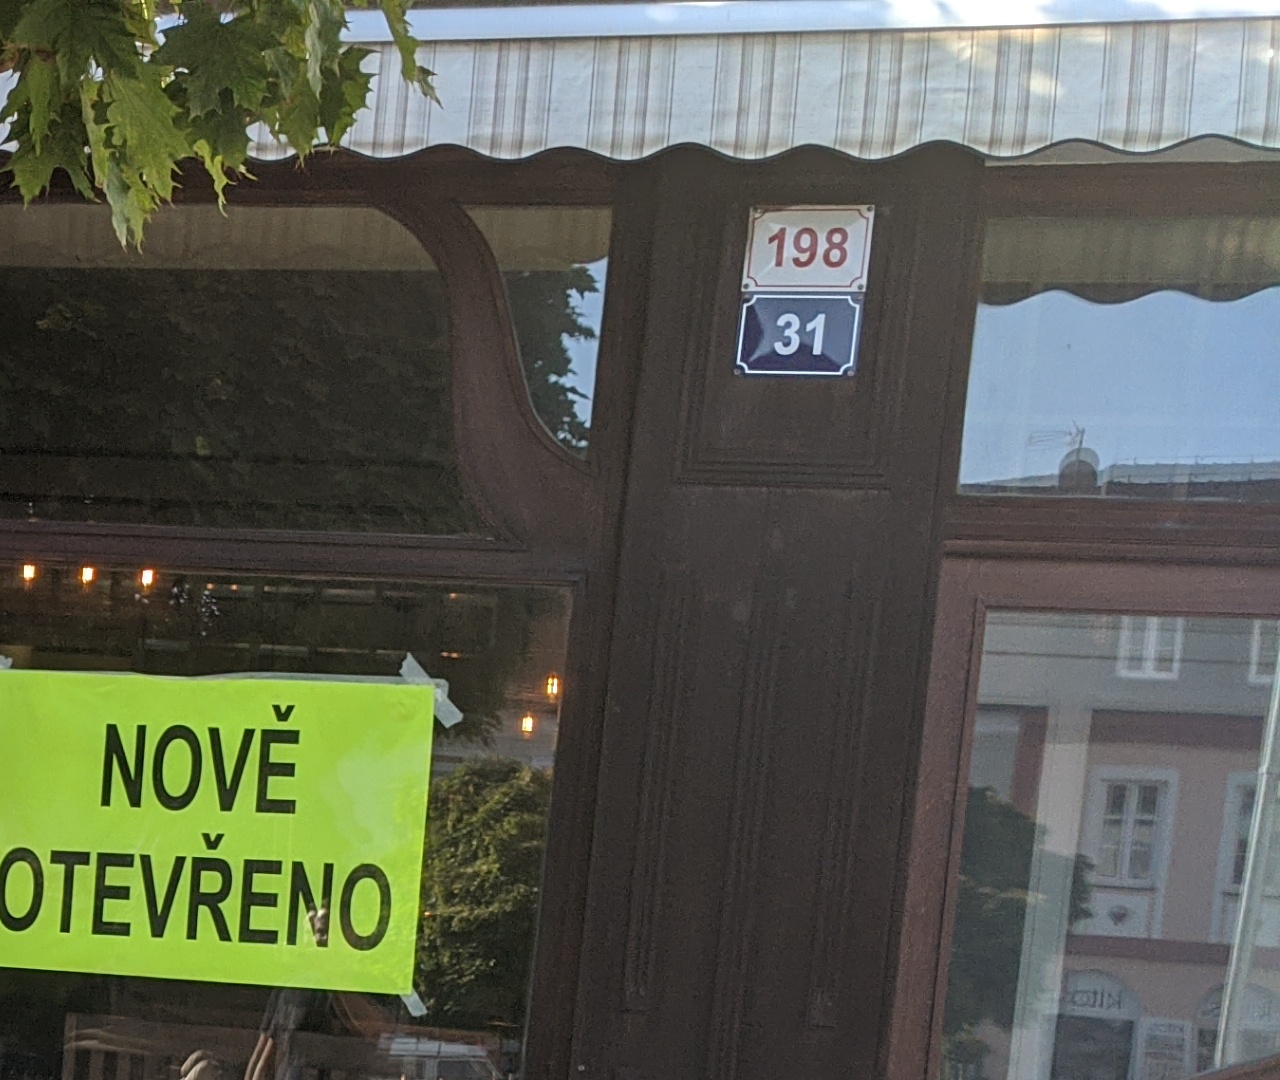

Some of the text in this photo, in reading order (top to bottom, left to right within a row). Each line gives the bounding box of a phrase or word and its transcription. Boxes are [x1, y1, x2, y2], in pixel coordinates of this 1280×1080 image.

[767, 226, 849, 269] 198
[773, 312, 826, 356] 31
[100, 704, 300, 814] NOVĚ
